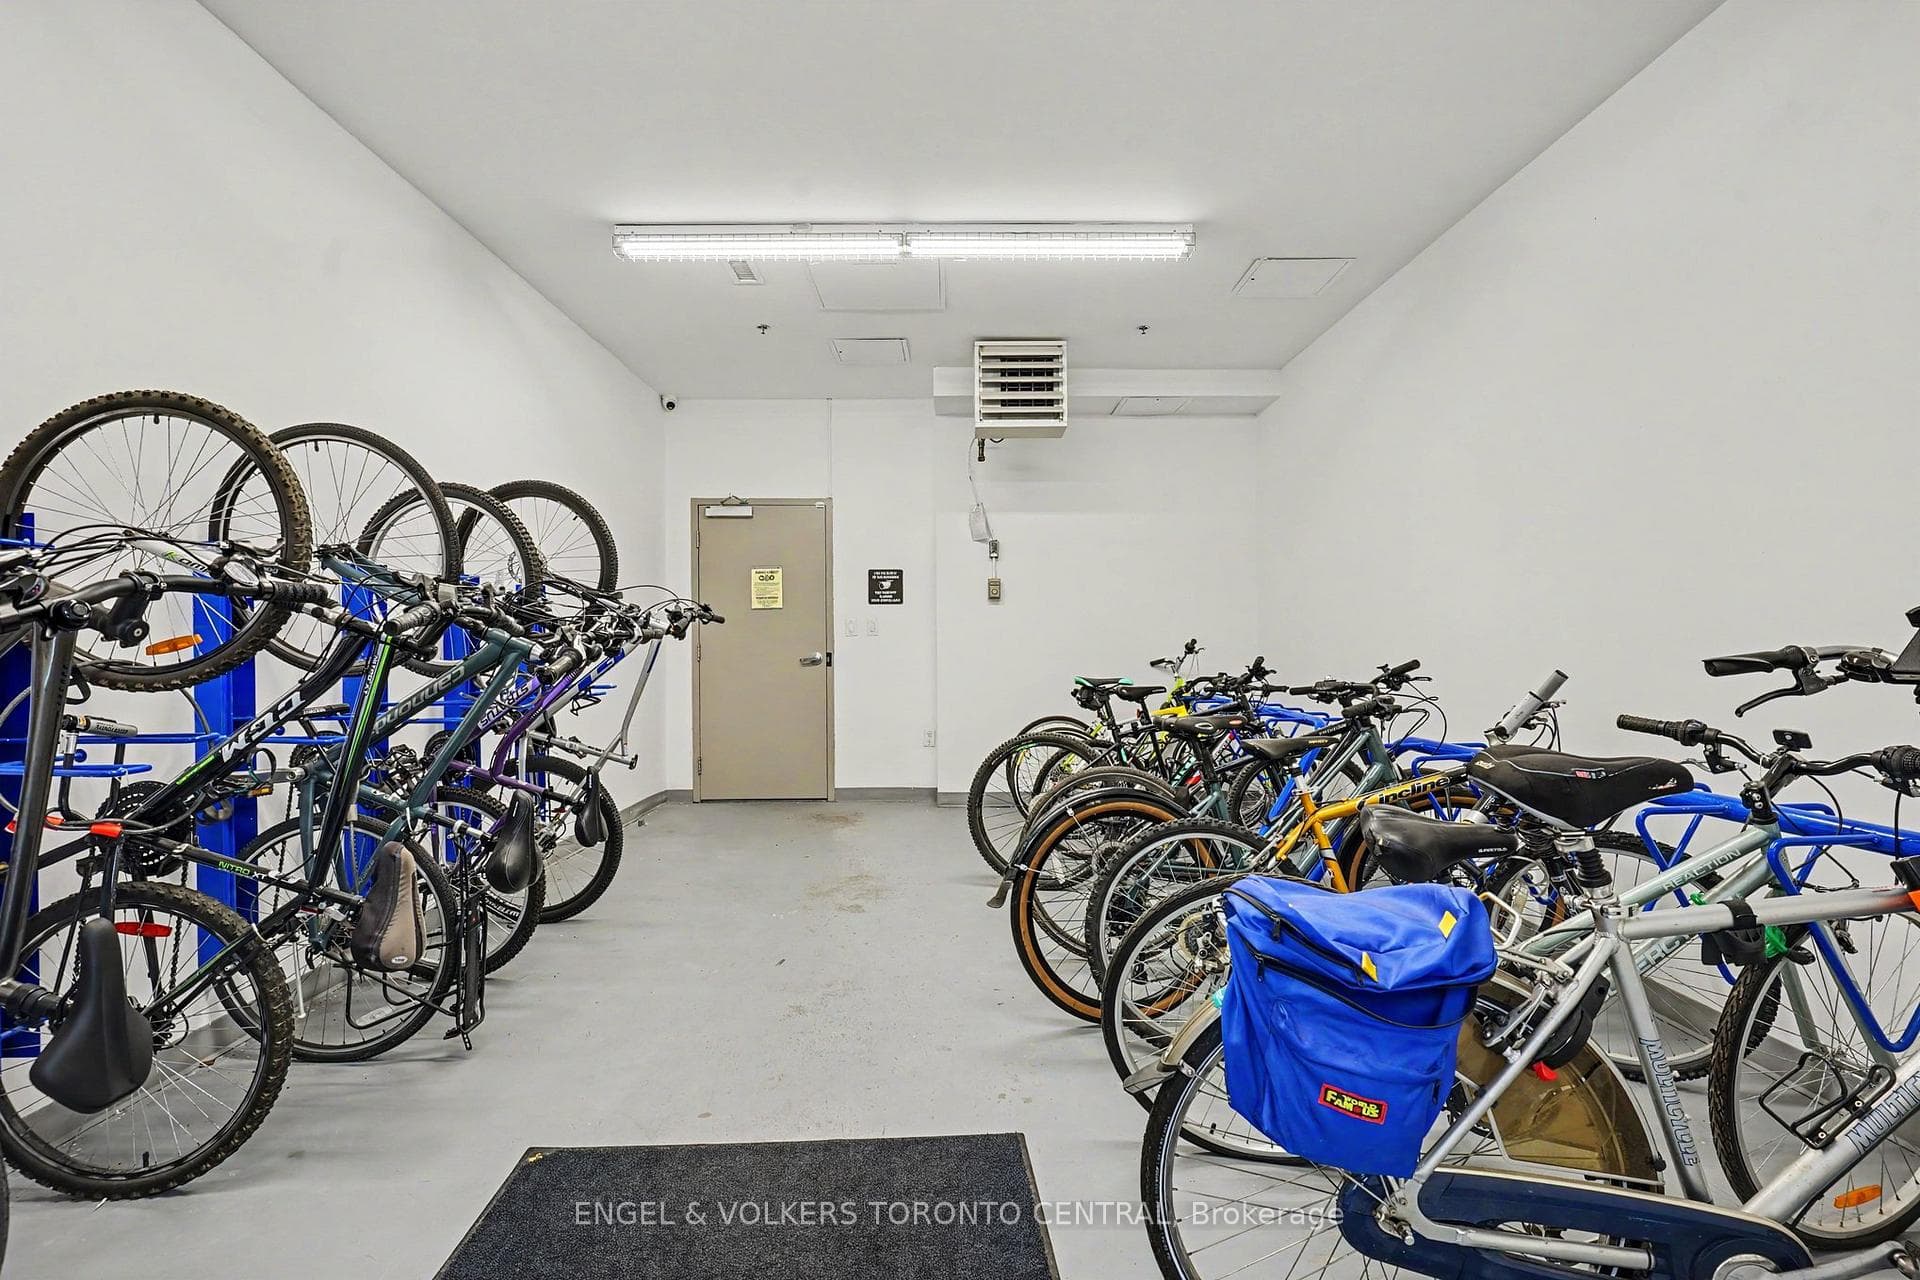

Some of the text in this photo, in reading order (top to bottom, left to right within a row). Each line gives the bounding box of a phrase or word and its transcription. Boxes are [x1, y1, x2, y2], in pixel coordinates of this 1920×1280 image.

[222, 691, 306, 761] CCM
[372, 664, 465, 732] cannond
[218, 861, 267, 880] NITRO XT
[1662, 848, 1741, 891] REACTION
[1638, 1037, 1700, 1167] MULTICYCLE
